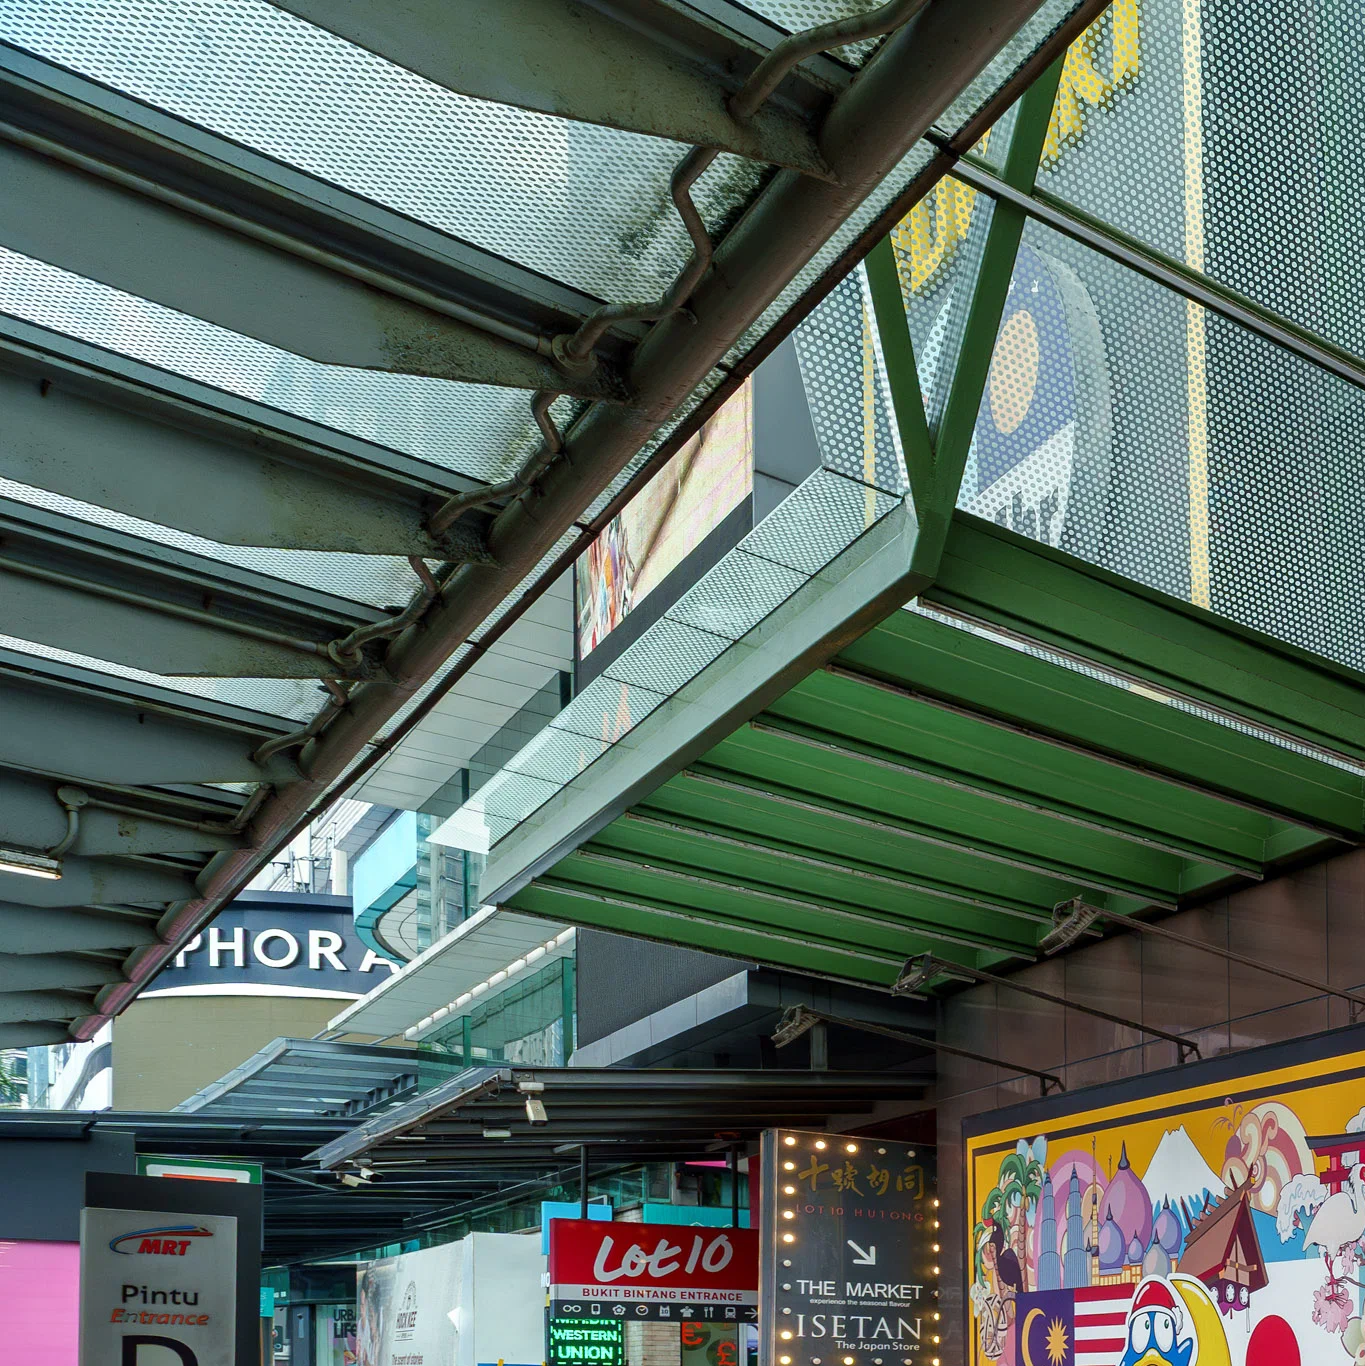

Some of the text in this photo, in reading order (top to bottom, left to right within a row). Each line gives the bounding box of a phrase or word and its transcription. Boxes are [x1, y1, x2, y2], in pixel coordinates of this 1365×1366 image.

[172, 927, 401, 973] PHORA
[796, 1203, 824, 1215] LOT
[831, 1206, 844, 1217] 10
[137, 1239, 192, 1256] MRT
[593, 1233, 735, 1283] Lot 10
[121, 1284, 200, 1307] Pintu
[582, 1287, 744, 1302] BUKIT BINTANG ENTRANCE
[796, 1279, 924, 1300] THE MARKET
[809, 1297, 911, 1309] experience the seasonal flavour
[110, 1308, 210, 1327] Entrance
[553, 1329, 618, 1342] WESTERN
[796, 1313, 922, 1341] ISETAN
[558, 1345, 614, 1360] UNION
[835, 1340, 921, 1352] The Japan Store
